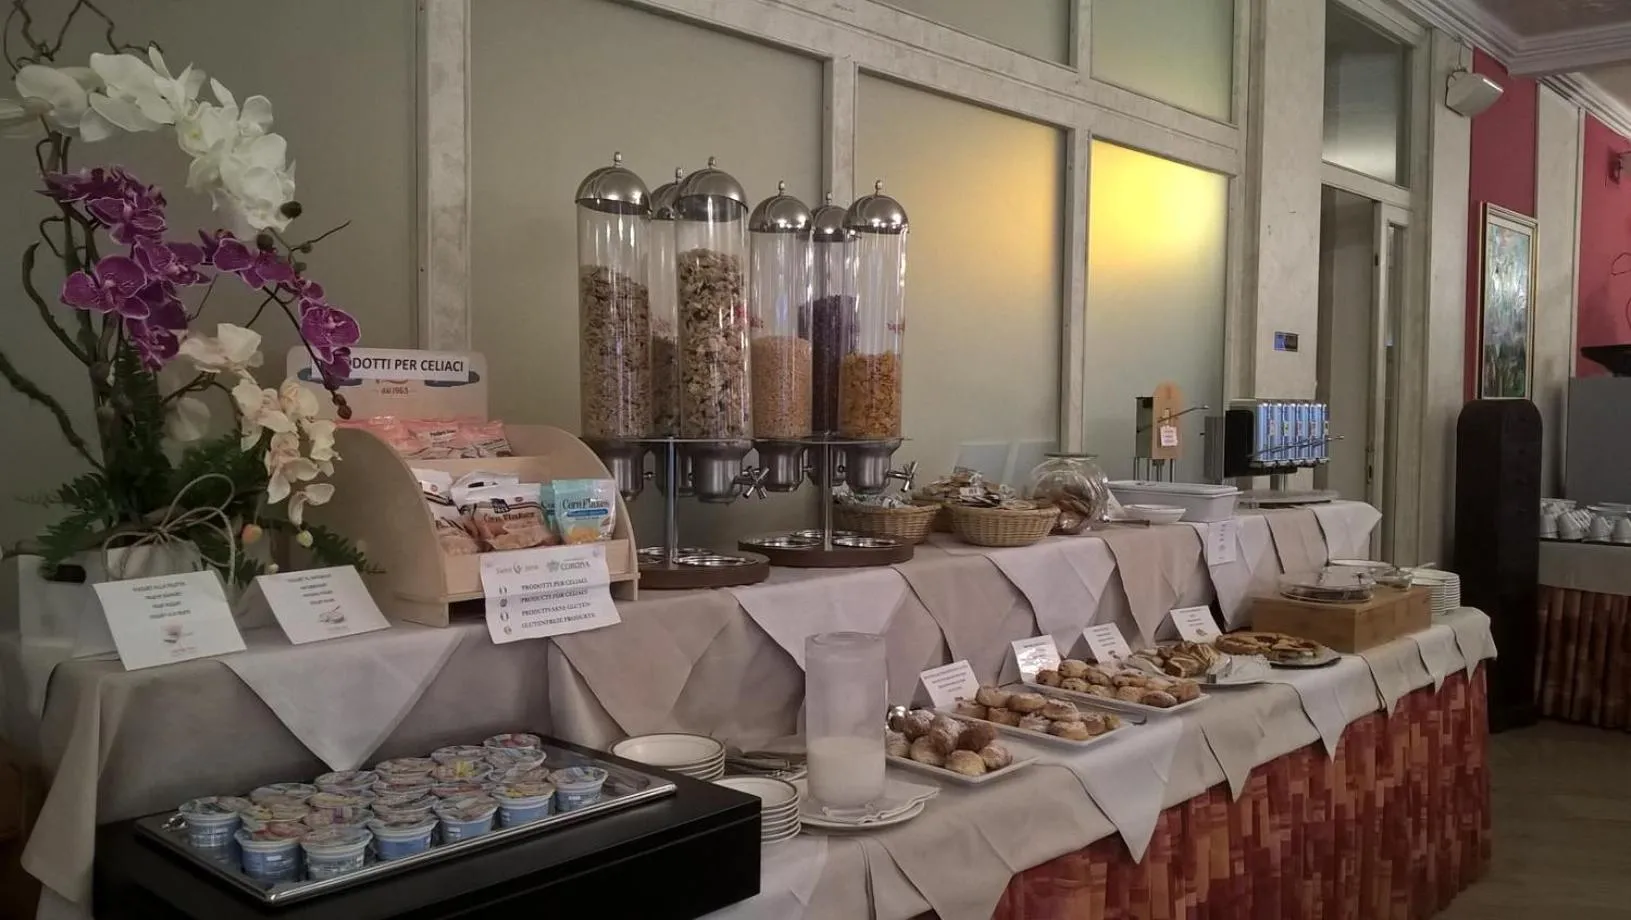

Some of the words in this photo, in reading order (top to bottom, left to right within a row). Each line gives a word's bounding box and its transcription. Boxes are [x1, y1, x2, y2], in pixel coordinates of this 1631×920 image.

[348, 357, 391, 371] DOTTI
[394, 358, 417, 371] PER
[420, 359, 464, 372] CELIACI
